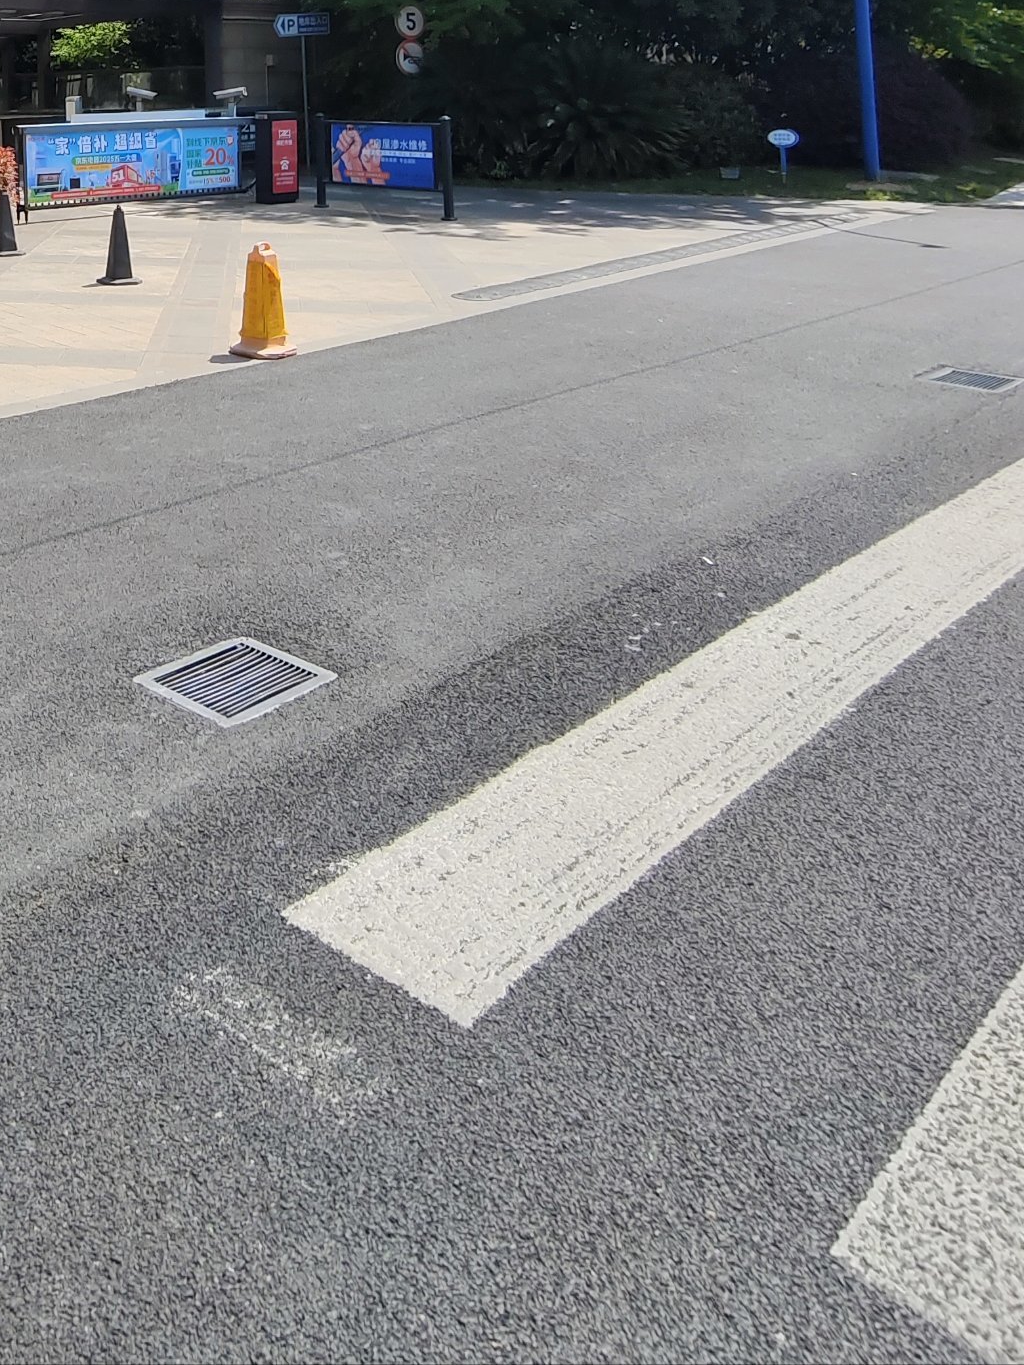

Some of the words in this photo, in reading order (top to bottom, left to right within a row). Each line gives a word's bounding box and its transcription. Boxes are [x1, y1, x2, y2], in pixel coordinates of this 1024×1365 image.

[287, 19, 296, 32] P
[406, 12, 416, 31] 5
[114, 132, 158, 150] 超级省
[112, 169, 125, 182] 51
